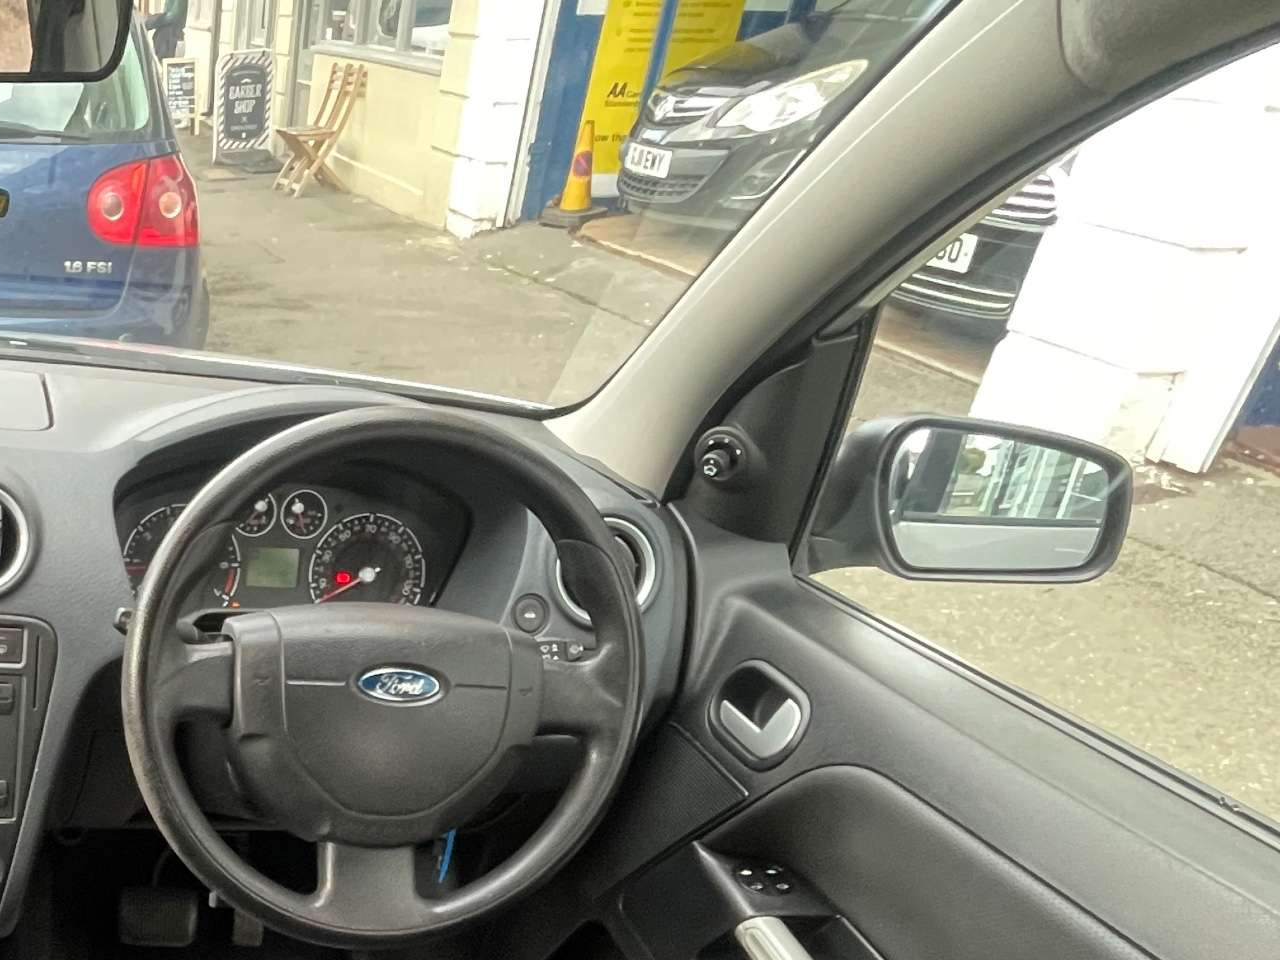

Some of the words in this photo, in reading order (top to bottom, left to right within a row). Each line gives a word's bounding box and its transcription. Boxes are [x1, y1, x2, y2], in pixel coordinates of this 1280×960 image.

[229, 84, 263, 100] BARBER
[234, 100, 256, 114] SHOP
[86, 261, 112, 274] FSI
[376, 673, 425, 695] Ford
